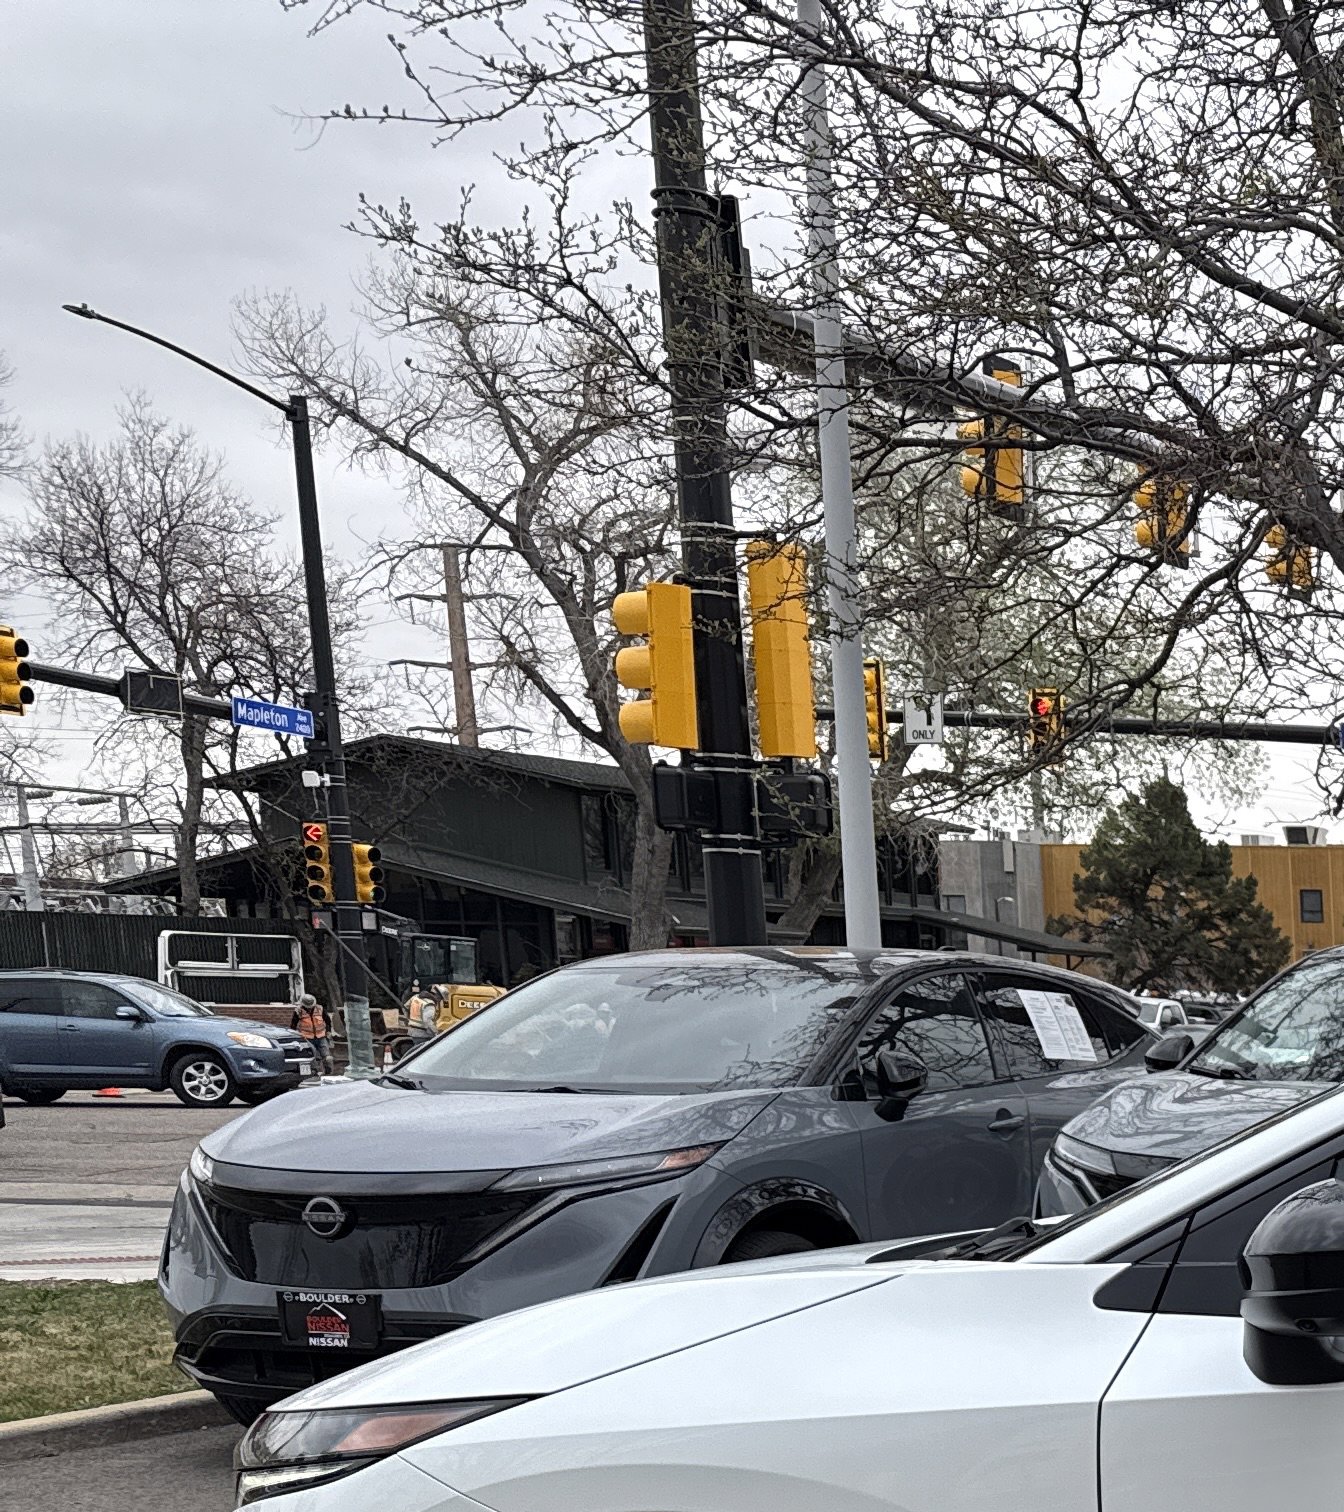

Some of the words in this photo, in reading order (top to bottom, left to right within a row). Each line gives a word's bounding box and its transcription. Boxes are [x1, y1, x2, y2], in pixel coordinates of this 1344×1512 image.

[237, 702, 289, 728] Mapleton
[912, 729, 936, 740] ONLY
[302, 1212, 345, 1222] NISSAN
[299, 1292, 350, 1304] BOULDER
[308, 1321, 350, 1333] NISSAN
[308, 1336, 349, 1347] NISSAN
